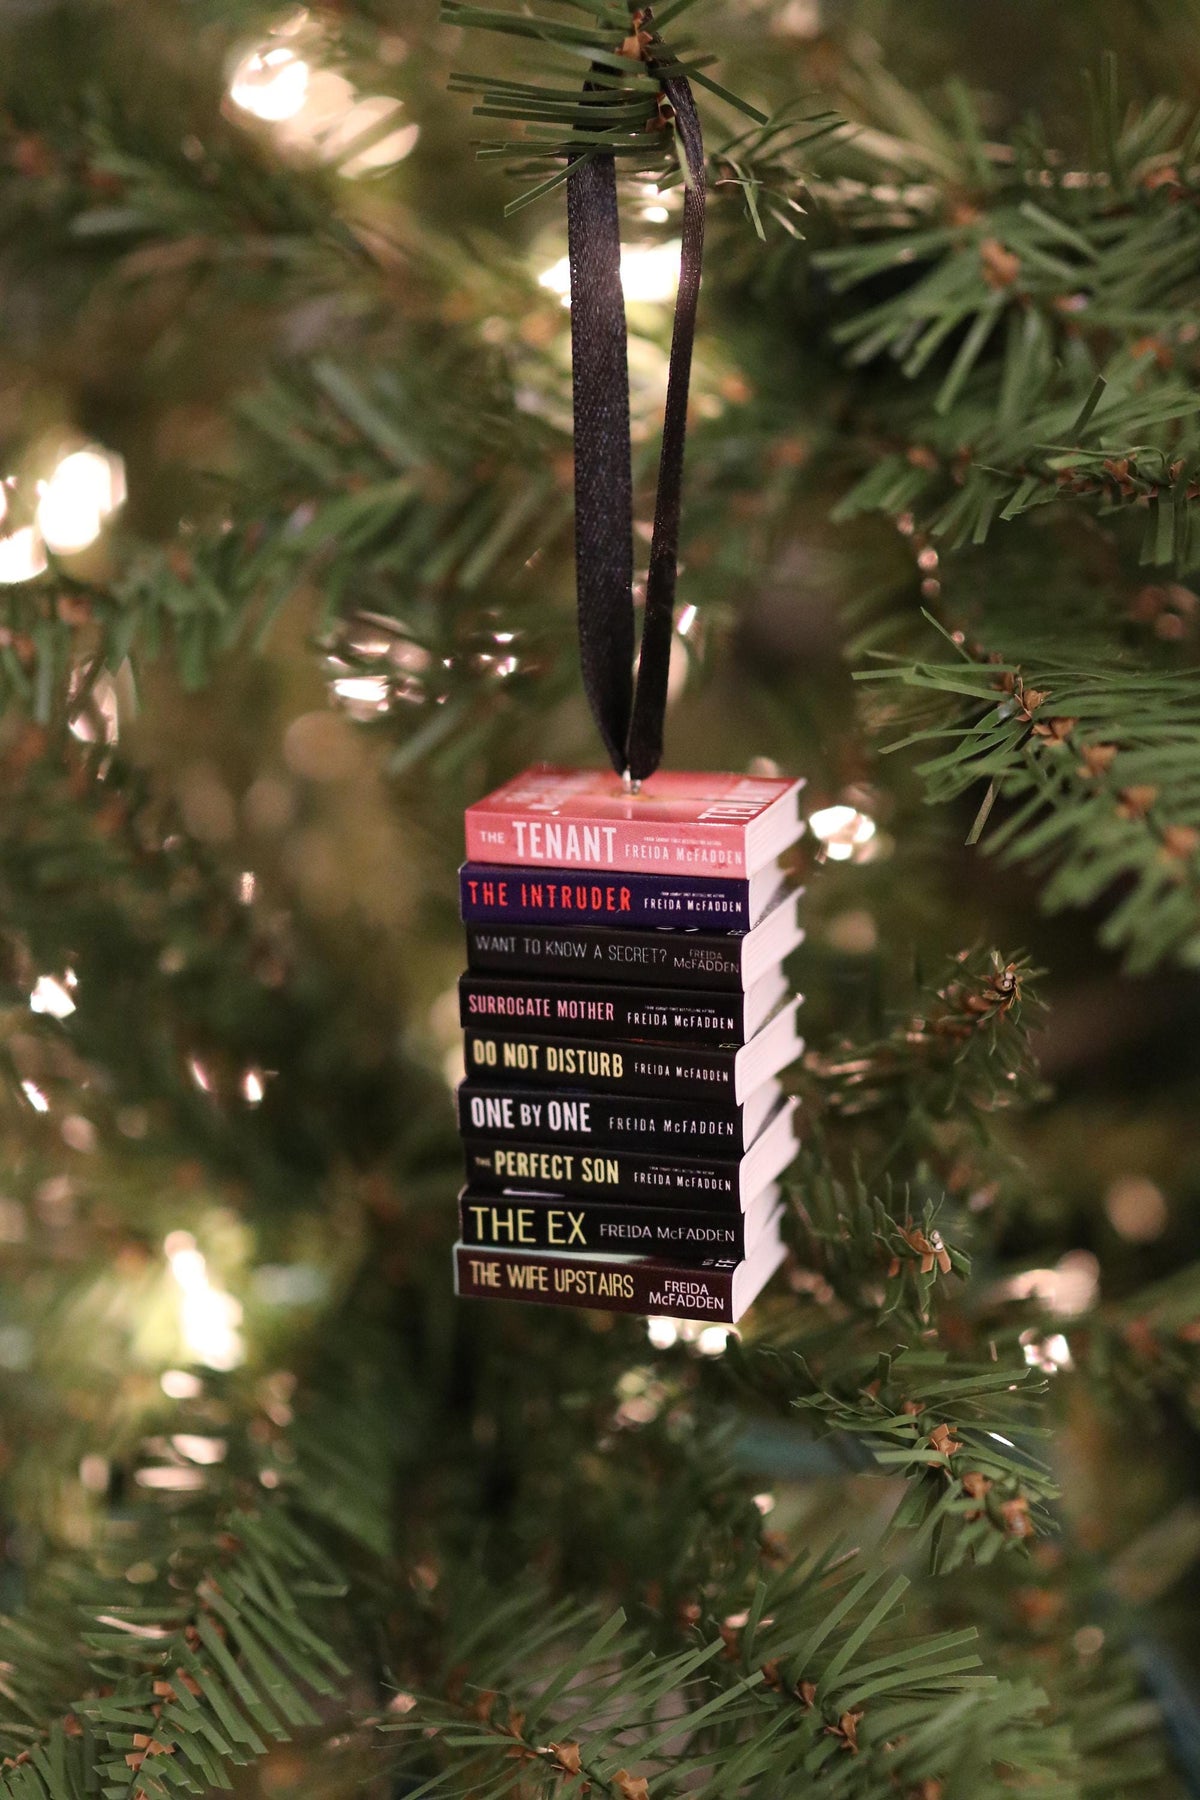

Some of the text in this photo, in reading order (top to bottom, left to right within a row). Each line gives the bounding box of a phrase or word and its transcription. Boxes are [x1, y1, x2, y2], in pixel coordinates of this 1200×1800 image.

[480, 821, 617, 863] THE TENANT
[625, 844, 743, 865] FREIDA McFADDEN
[468, 881, 631, 911] THE INTRUDER
[644, 898, 742, 912] FREIDA McFADDEN
[476, 936, 667, 963] WANT TO KNOW A SECRET?
[689, 949, 722, 960] FREIDA
[673, 957, 740, 973] McFADDEN
[468, 994, 614, 1020] SURROGATE MOTHER
[627, 1012, 734, 1029] FREIDA McFADDEN
[473, 1039, 623, 1077] DO NOT DISTURB
[634, 1063, 729, 1082] FREIDA McFADDEN
[471, 1097, 592, 1132] ONE BY ONE
[609, 1117, 734, 1135] FREIDA McFADDEN
[495, 1150, 574, 1180] PERFECT
[582, 1157, 620, 1184] SON
[634, 1172, 731, 1191] FREIDA McFADDEN
[469, 1206, 587, 1245] THE EX
[600, 1224, 735, 1242] FREIDA McFADDEN
[469, 1261, 634, 1298] THE WIFE UPSTAIRS
[664, 1280, 709, 1296] FREIDA
[649, 1291, 724, 1310] McFADDEN
